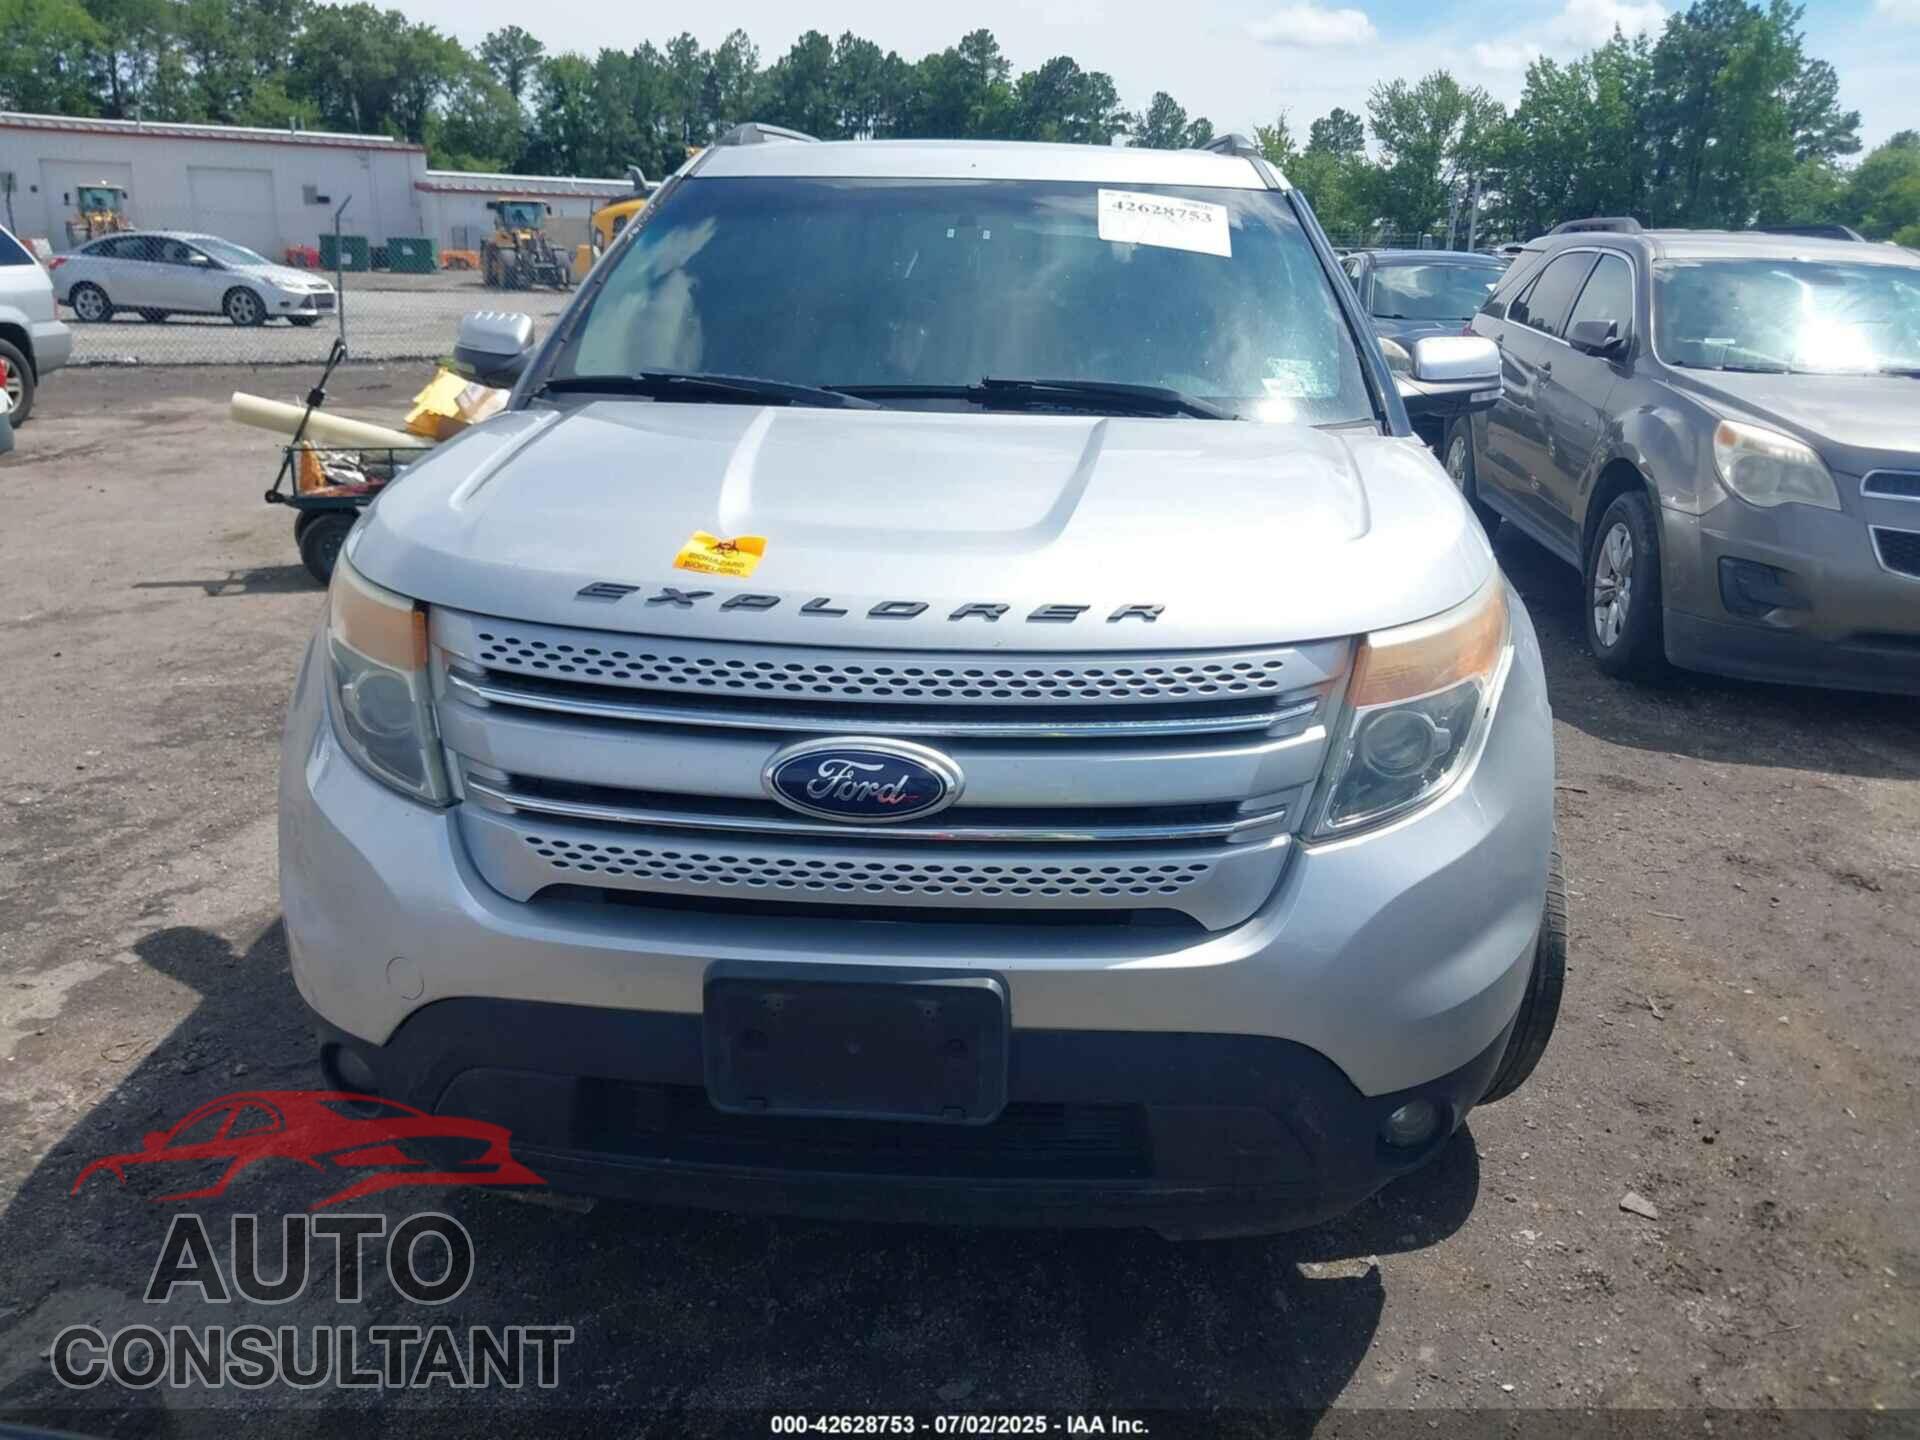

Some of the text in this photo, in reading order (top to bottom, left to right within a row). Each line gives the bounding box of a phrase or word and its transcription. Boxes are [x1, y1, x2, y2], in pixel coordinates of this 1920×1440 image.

[1112, 200, 1213, 223] 42628753
[575, 581, 1166, 623] EXPLORER
[806, 759, 911, 804] Ford
